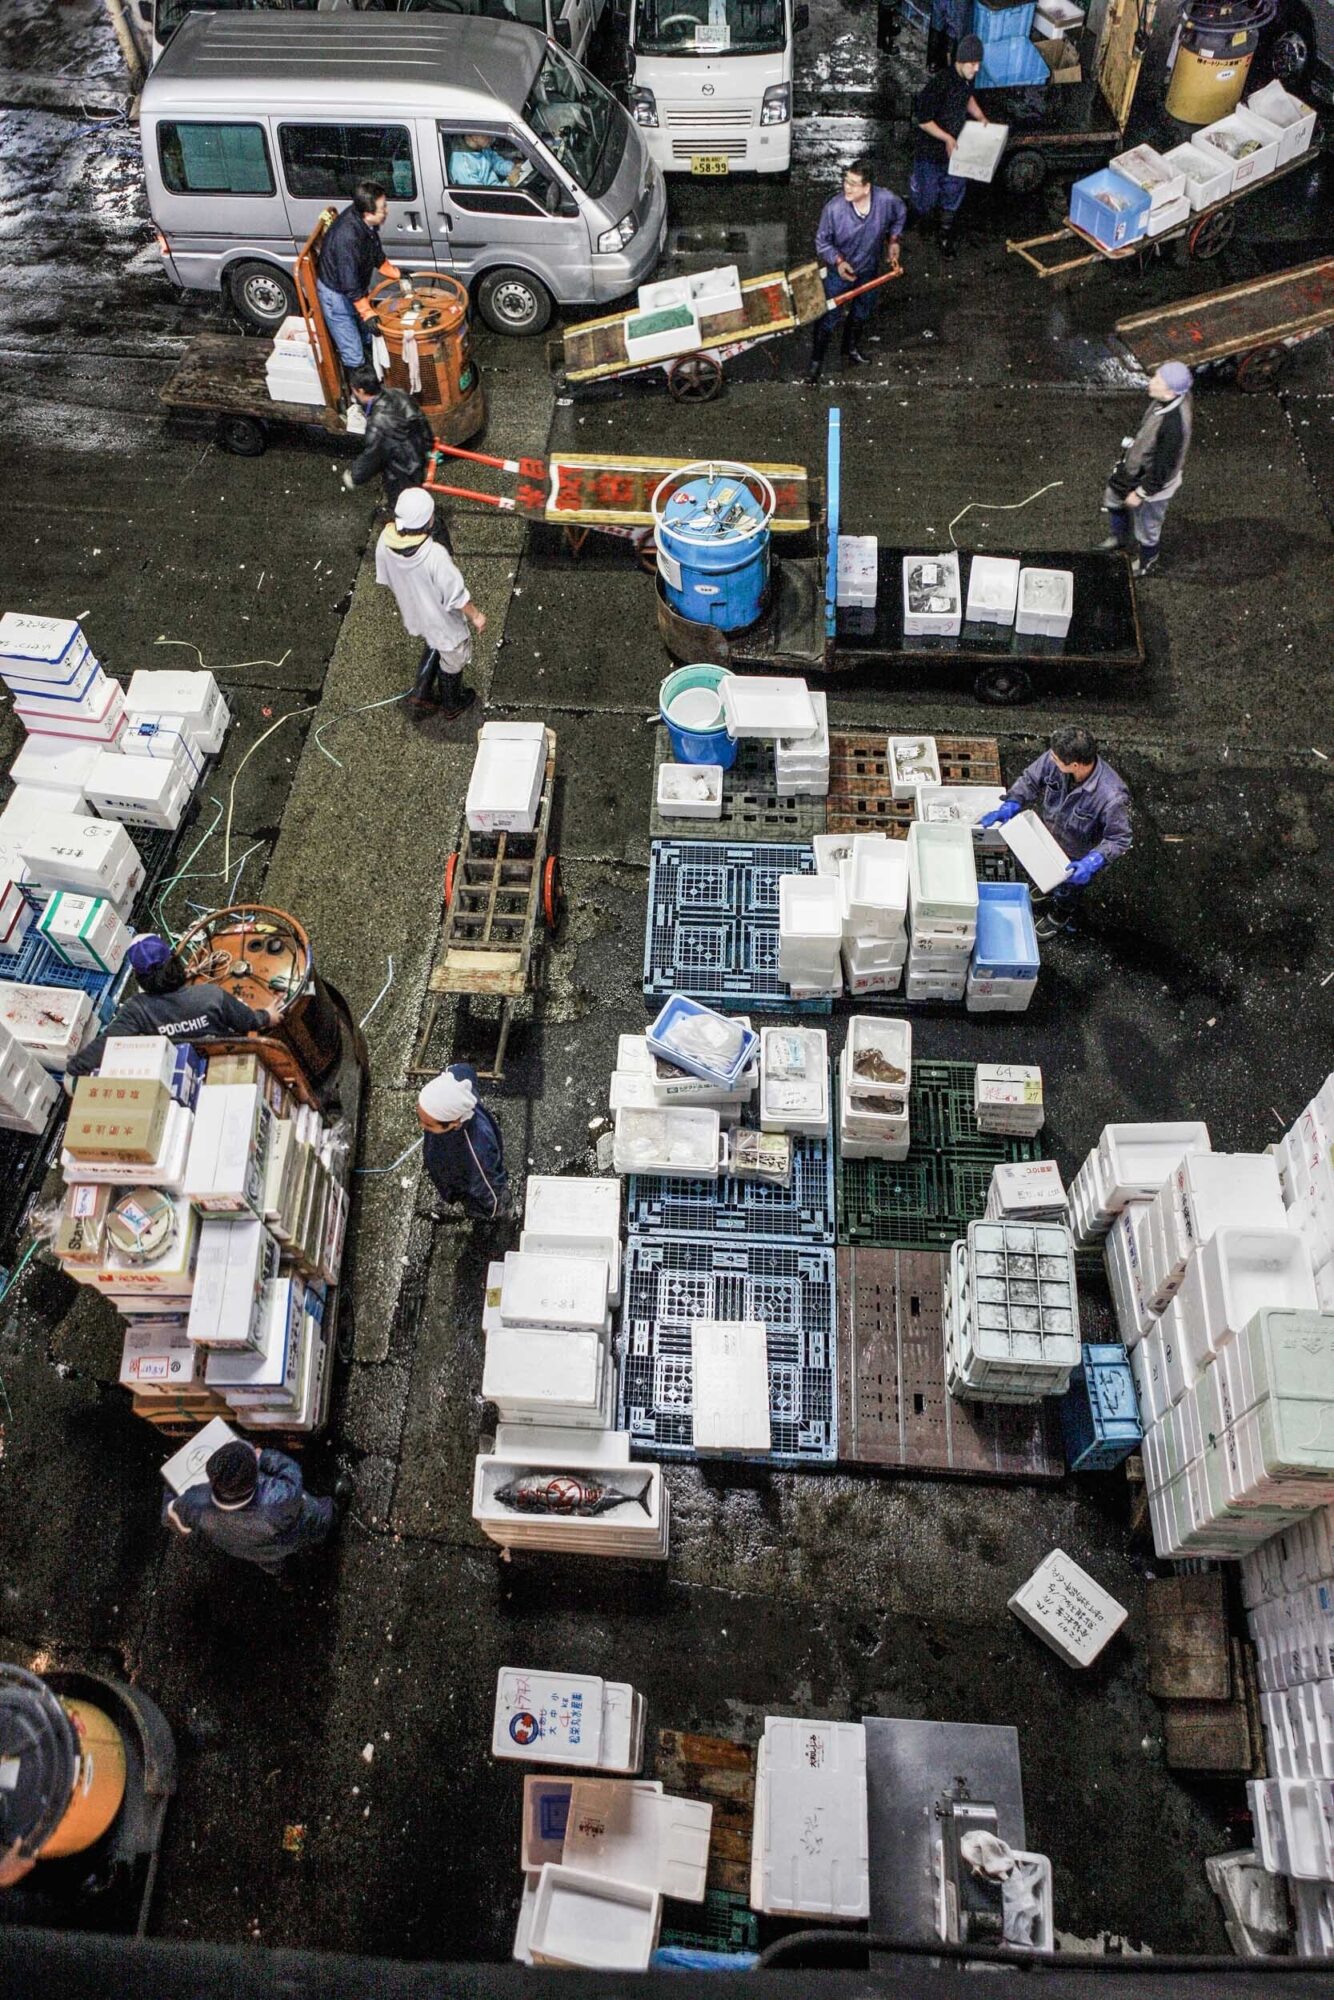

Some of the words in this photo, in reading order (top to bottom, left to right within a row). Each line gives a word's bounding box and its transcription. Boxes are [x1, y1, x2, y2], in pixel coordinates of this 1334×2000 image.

[699, 163, 726, 173] 58-99
[158, 1015, 209, 1036] POOCHIE
[68, 1216, 84, 1250] Stan
